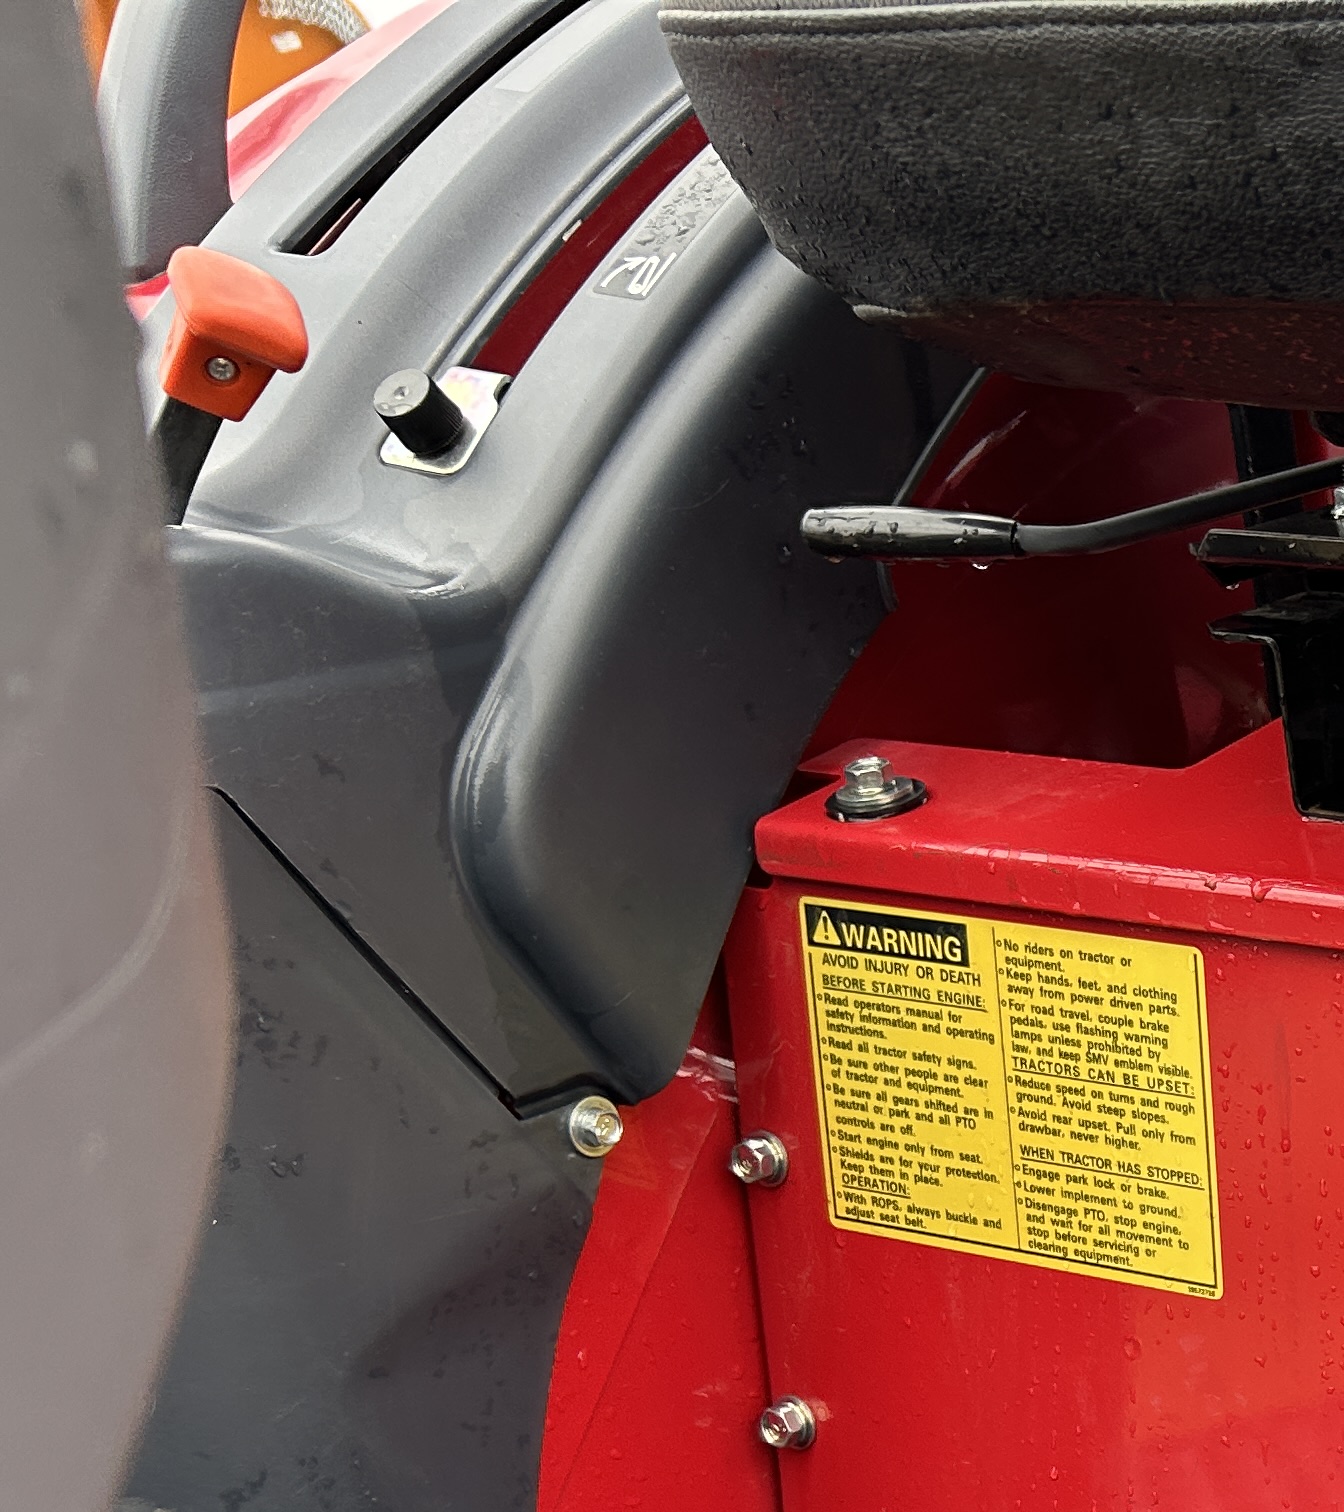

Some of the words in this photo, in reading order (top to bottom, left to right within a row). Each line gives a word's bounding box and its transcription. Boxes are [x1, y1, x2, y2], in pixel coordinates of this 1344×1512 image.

[840, 921, 963, 962] WARNING
[1002, 938, 1020, 953] No
[1023, 941, 1055, 958] riders
[1059, 948, 1074, 960] on
[1077, 949, 1116, 966] tractor
[1119, 956, 1133, 968] or
[821, 951, 860, 971] AVOID
[863, 957, 910, 978] INJURY
[915, 964, 935, 981] OR
[938, 967, 982, 988] DEATH
[1005, 966, 1033, 985] Keep
[1106, 983, 1128, 996] and
[1132, 985, 1178, 1005] clothing
[821, 973, 867, 993] BEFORE
[871, 979, 932, 1002] STARTING
[1006, 983, 1035, 999] away
[1038, 985, 1066, 1002] from
[1069, 992, 1105, 1007] power
[1109, 995, 1144, 1013] driven
[827, 1035, 854, 1052] Read
[857, 1040, 871, 1055] all
[873, 1043, 908, 1060] tractor
[911, 1050, 943, 1068] safety
[1010, 1054, 1081, 1079] TRACTORS
[1087, 1067, 1116, 1084] CAN
[1122, 1072, 1140, 1088] BE
[1069, 1129, 1100, 1144] never
[1018, 1143, 1055, 1162] WHEN
[1058, 1149, 1113, 1172] TRACTOR
[1114, 1160, 1142, 1176] HAS
[1021, 1163, 1061, 1183] Engage
[1064, 1172, 1089, 1187] park
[1092, 1175, 1116, 1191] lock
[1120, 1182, 1132, 1194] or
